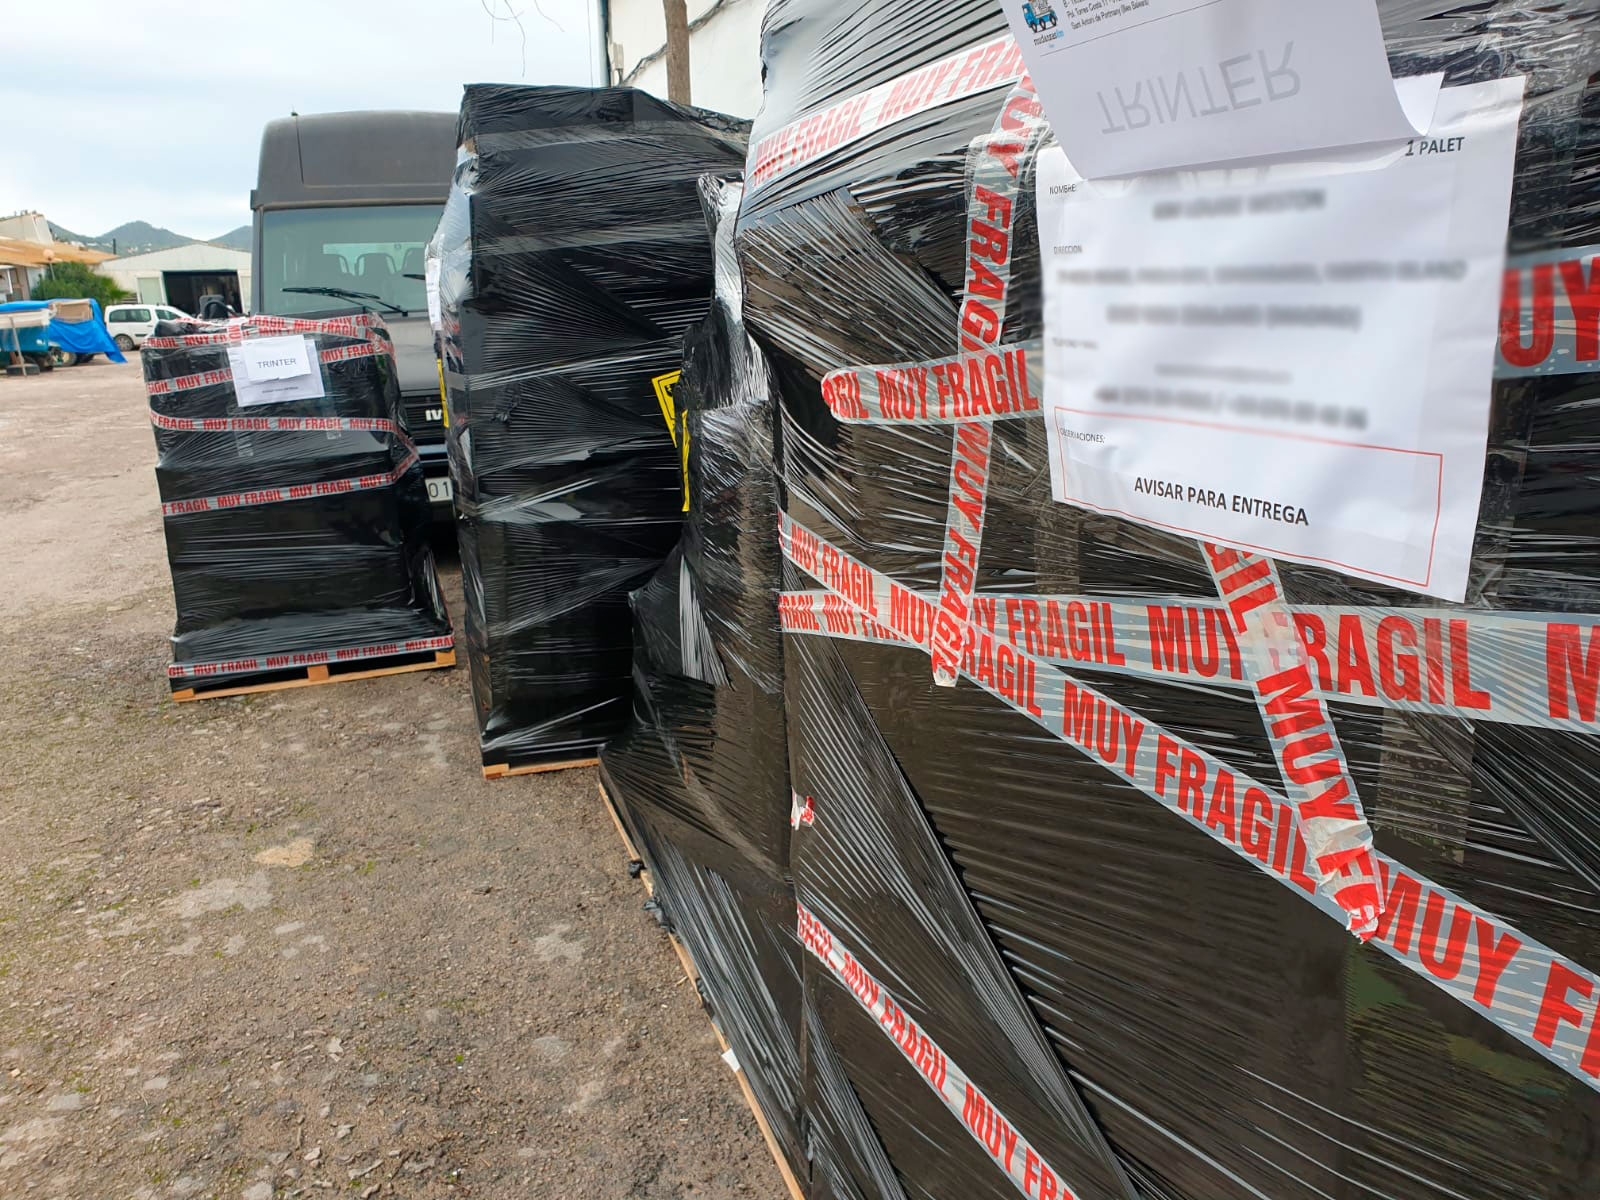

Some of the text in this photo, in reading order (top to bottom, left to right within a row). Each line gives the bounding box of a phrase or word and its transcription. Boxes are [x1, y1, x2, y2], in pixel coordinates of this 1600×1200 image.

[877, 61, 953, 125] MUY
[1406, 136, 1466, 156] 1 PALET
[961, 76, 1043, 351] UY FRAG
[1499, 256, 1600, 367] UY
[175, 375, 202, 390] MUY
[203, 367, 233, 385] FRAG
[256, 357, 297, 369] TRINTER
[321, 343, 375, 363] MUY FRAG
[822, 372, 869, 419] AGIL
[875, 367, 928, 420] MUY
[931, 349, 1039, 419] FRAGIL
[203, 418, 228, 431] MUY
[231, 418, 271, 431] FRAGIL
[278, 418, 301, 431] MUY
[305, 418, 343, 431] FRAGIL
[349, 418, 374, 430] MUY
[170, 498, 211, 514] FRAGIL
[216, 495, 241, 508] MUY
[244, 489, 284, 504] FRAGIL
[289, 485, 313, 498] MUY
[316, 480, 353, 495] FRAGIL
[359, 475, 382, 488] MUY
[427, 481, 450, 498] 01
[952, 420, 989, 534] MUY
[1134, 476, 1310, 527] AVISAR PARA ENTREGA
[221, 659, 259, 673] FRAGIL
[265, 655, 290, 668] MUY
[292, 651, 329, 665] FRAGIL
[336, 648, 360, 660] MUY
[363, 643, 399, 656] FRAGIL
[1005, 598, 1125, 667] FRAGIL
[1146, 604, 1243, 681] MUY
[791, 523, 820, 571] MUY
[821, 541, 878, 618] FRAGIL
[961, 625, 1042, 718] RAGIL
[1062, 680, 1144, 778] MUY
[1153, 733, 1317, 896] FRAGIL
[1376, 859, 1523, 1009] MUY
[1257, 664, 1360, 822] MUY
[880, 992, 950, 1100] FRAGIL
[962, 1081, 1018, 1175] MUY
